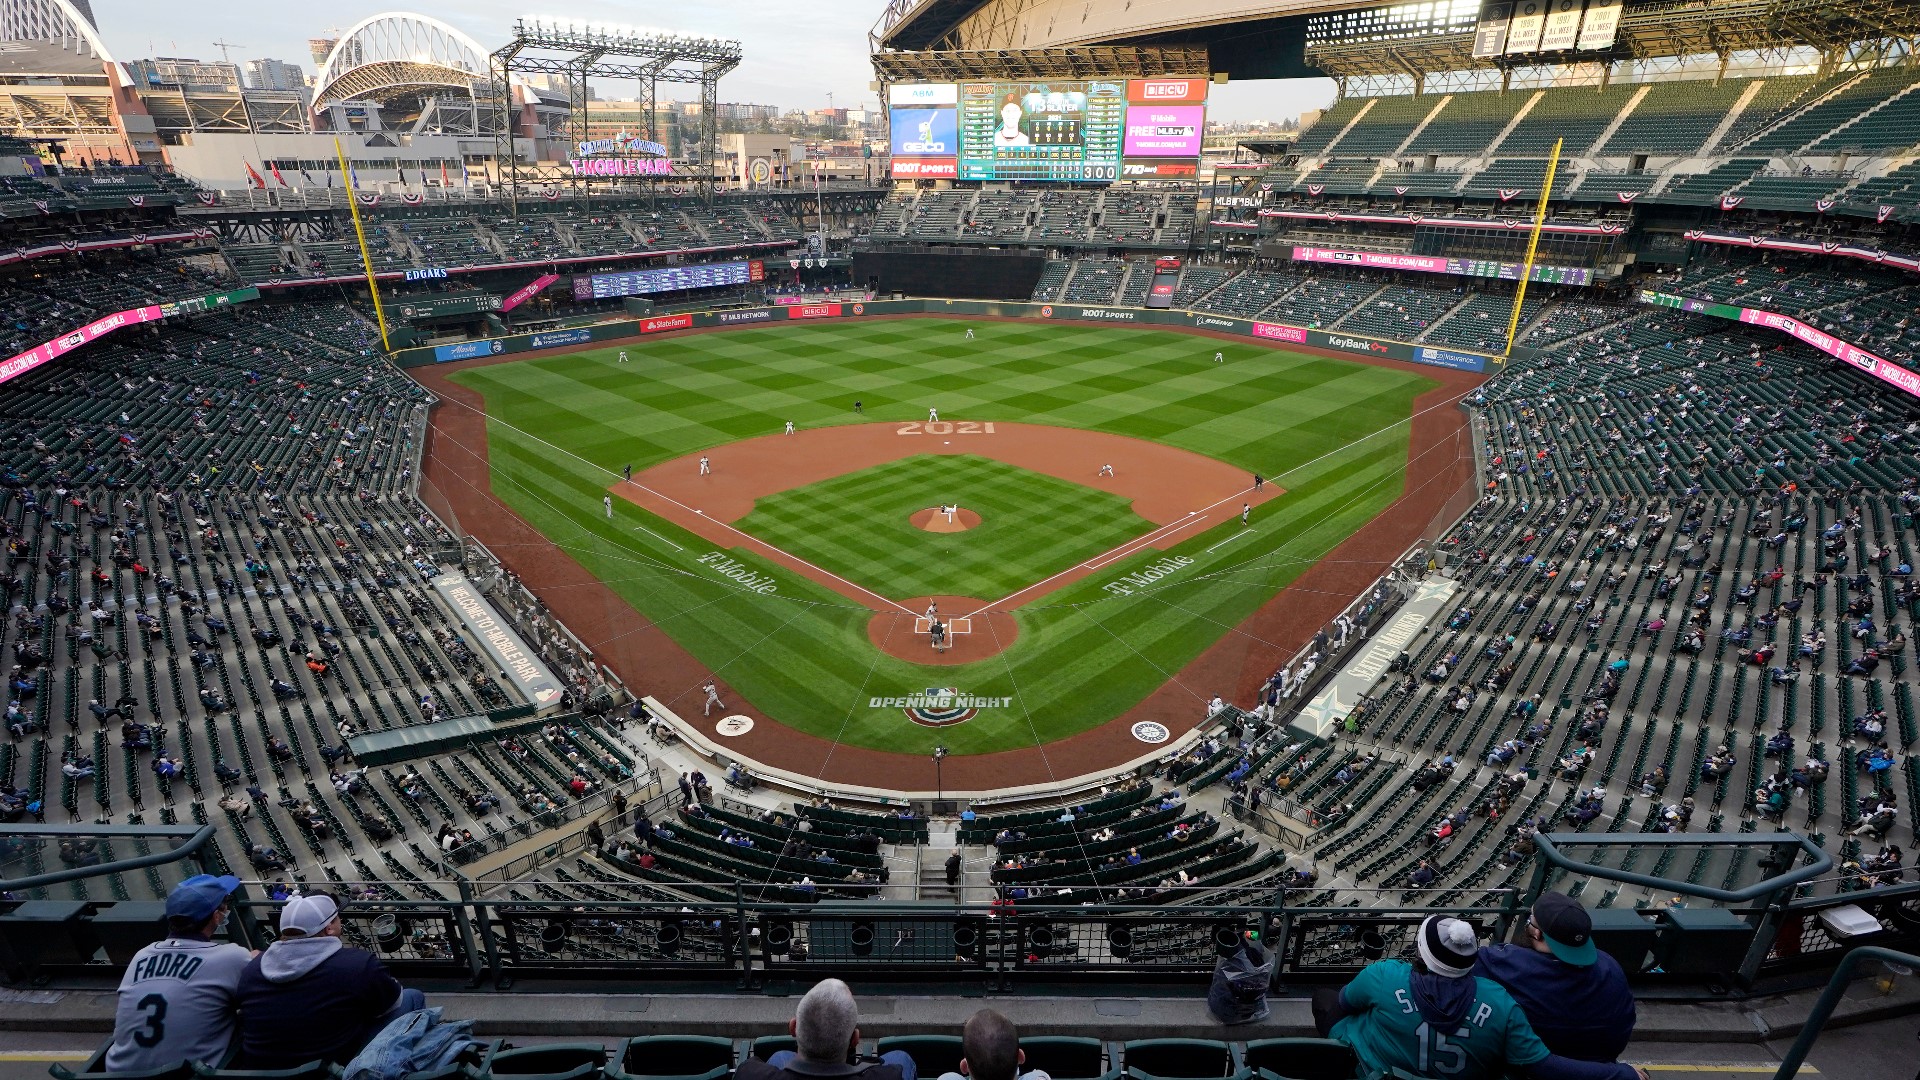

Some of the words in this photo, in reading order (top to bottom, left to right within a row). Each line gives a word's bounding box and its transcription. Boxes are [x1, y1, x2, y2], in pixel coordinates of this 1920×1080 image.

[1543, 35, 1573, 46] CHAMPIONS
[1581, 32, 1614, 43] CHAMPIONS
[1507, 39, 1538, 49] CHAMPIONS
[1147, 85, 1185, 95] BECU
[1129, 126, 1155, 136] FREE
[903, 142, 945, 152] GEICO
[570, 159, 637, 175] T-MOBILE
[638, 159, 673, 175] PARK
[893, 163, 919, 173] ROOT
[1084, 167, 1092, 178] 3
[1096, 167, 1103, 178] 0
[1107, 167, 1114, 178] 0
[1214, 197, 1231, 206] MLB
[1244, 198, 1263, 207] BLM
[1317, 251, 1332, 259] FREE
[1366, 254, 1434, 268] T-MOBILE.COM/MLB
[405, 268, 447, 281] EDGARS
[728, 313, 741, 321] MLB
[741, 311, 769, 320] NETWORK
[1082, 309, 1105, 318] ROOT
[1105, 311, 1134, 319] SPORTS
[1205, 318, 1234, 327] BOEING
[1765, 315, 1783, 327] FREE
[1328, 335, 1371, 351] KeyBank
[451, 344, 477, 354] Alaska
[897, 421, 996, 436] 2021
[448, 586, 487, 620] WELCOME
[475, 615, 495, 629] TO
[483, 625, 524, 661] T-MOBILE
[1347, 644, 1396, 681] SEATTLE
[509, 657, 542, 683] PARK
[868, 696, 951, 708] OPENING
[954, 696, 1013, 708] NIGHT
[133, 992, 169, 1049] 3
[1415, 1020, 1471, 1075] 15
